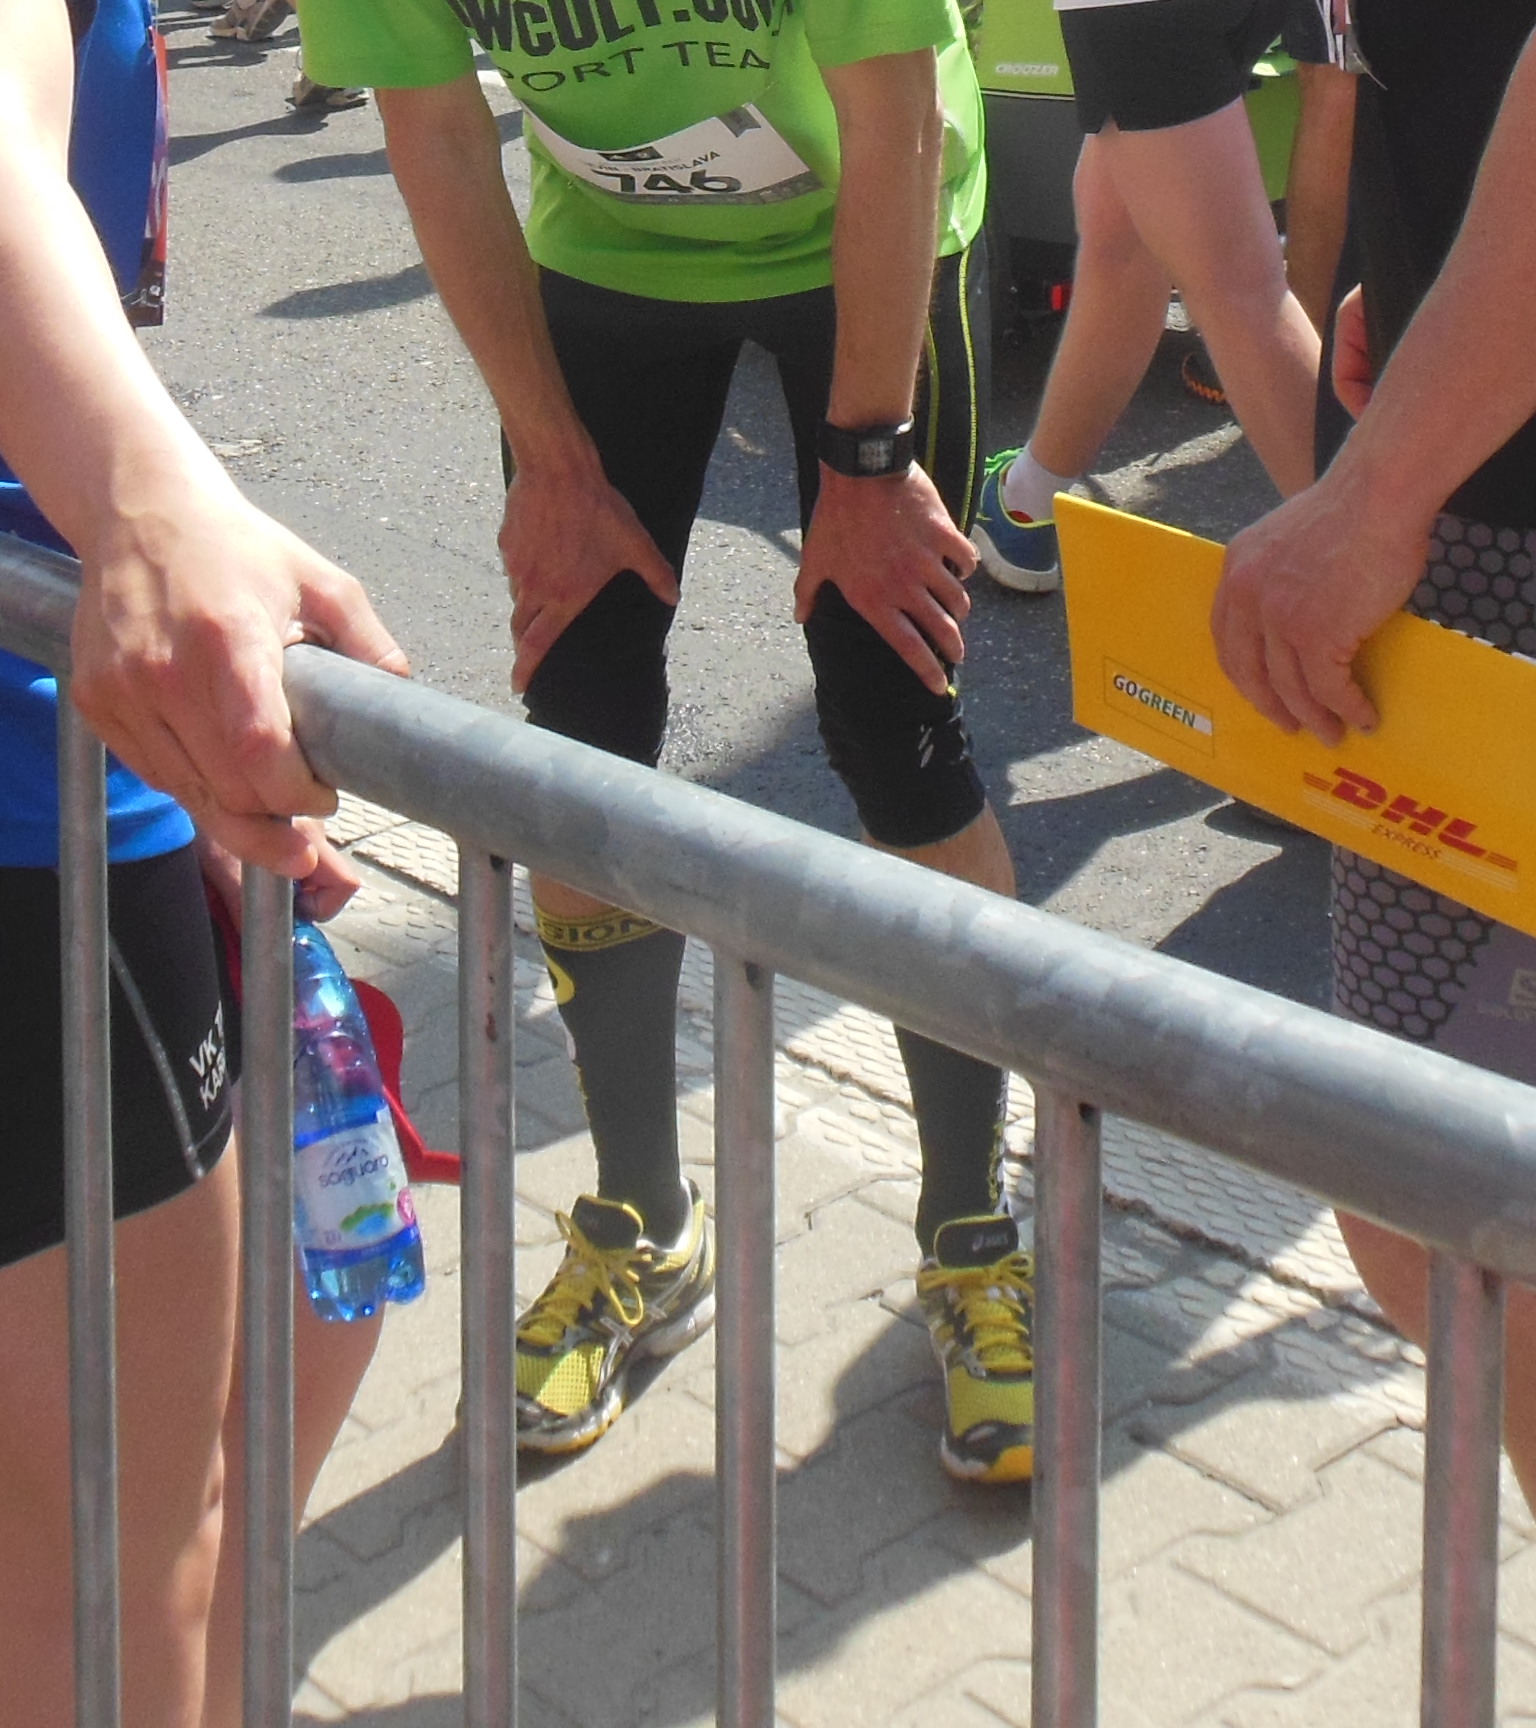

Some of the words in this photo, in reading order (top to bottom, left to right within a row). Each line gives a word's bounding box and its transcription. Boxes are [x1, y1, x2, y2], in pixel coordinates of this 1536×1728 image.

[591, 168, 742, 194] 746
[1113, 674, 1197, 729] GOGREEN
[1330, 766, 1488, 858] DHL
[1371, 823, 1442, 861] EXPRESS
